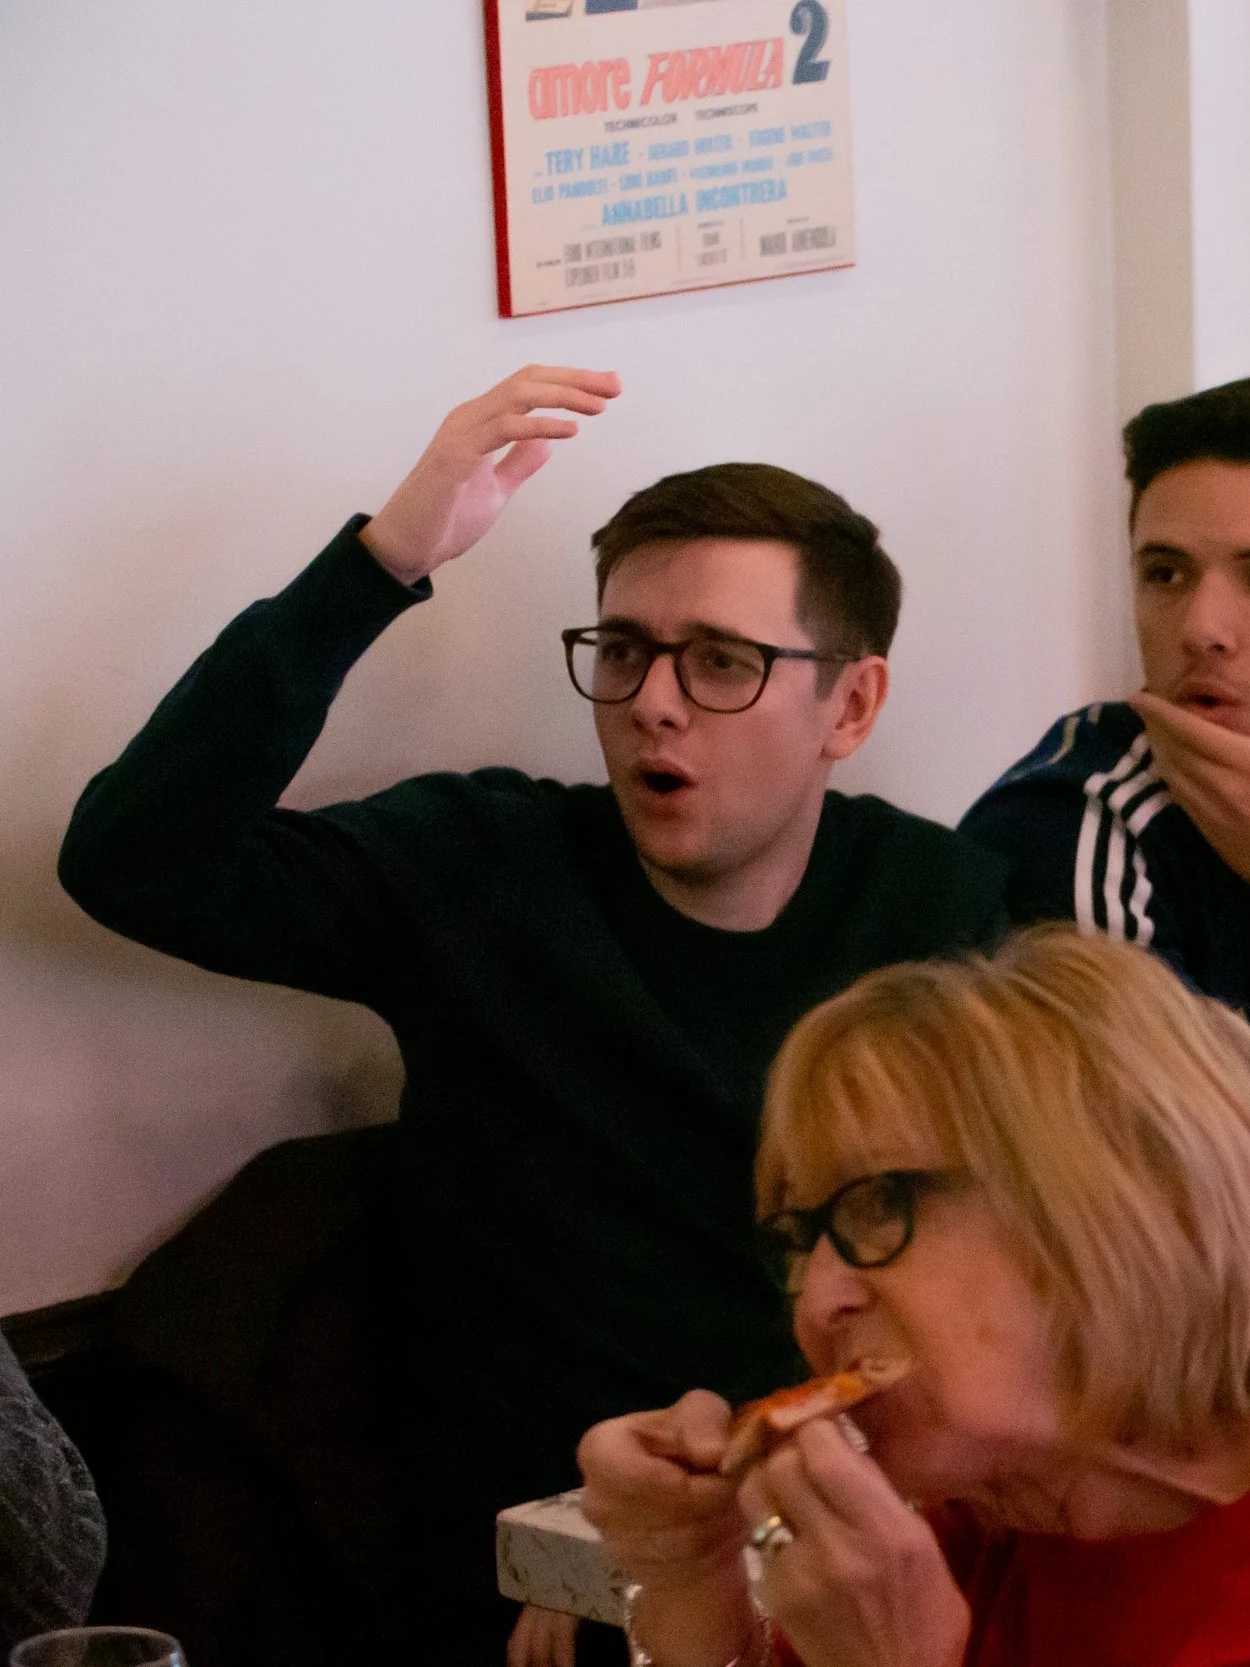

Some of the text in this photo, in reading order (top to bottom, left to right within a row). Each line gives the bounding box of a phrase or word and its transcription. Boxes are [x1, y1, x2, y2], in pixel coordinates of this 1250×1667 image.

[528, 0, 830, 120] amore FORMULA 2
[545, 148, 583, 176] TERY
[590, 141, 631, 169] HARE
[602, 178, 787, 226] ANNABELLA INCONTRERA
